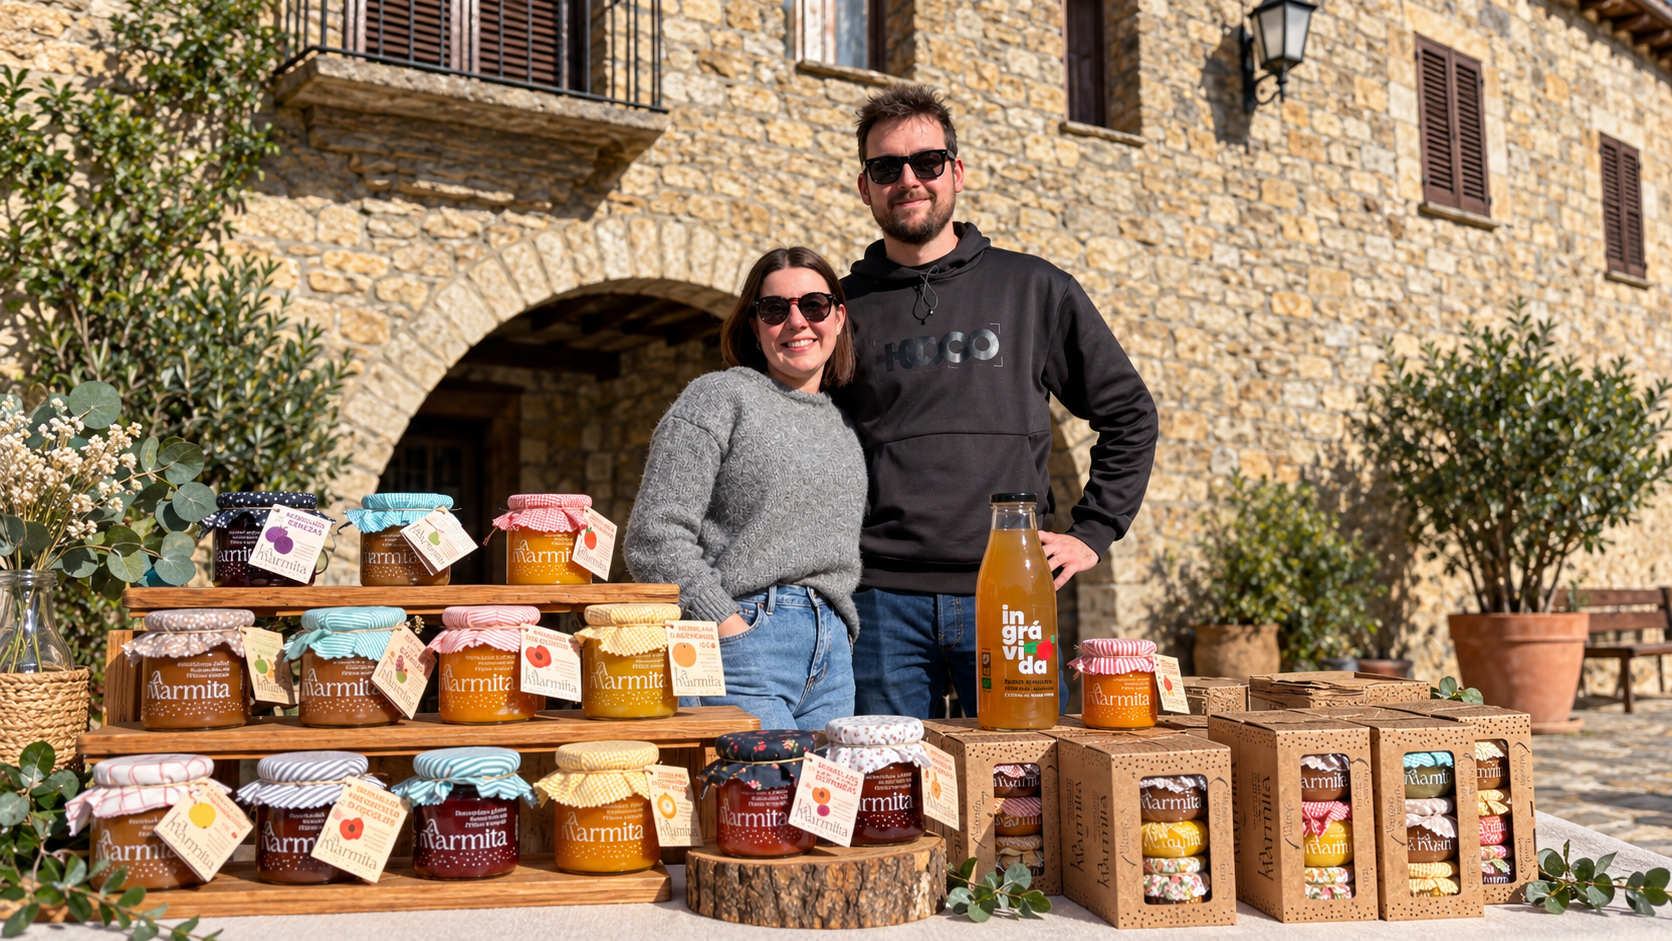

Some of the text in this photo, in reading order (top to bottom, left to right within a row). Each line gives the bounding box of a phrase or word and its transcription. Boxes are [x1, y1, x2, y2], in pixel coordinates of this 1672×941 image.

[1002, 604, 1025, 625] in
[1002, 620, 1042, 645] grá
[1002, 640, 1025, 660] vi
[1018, 655, 1047, 675] da
